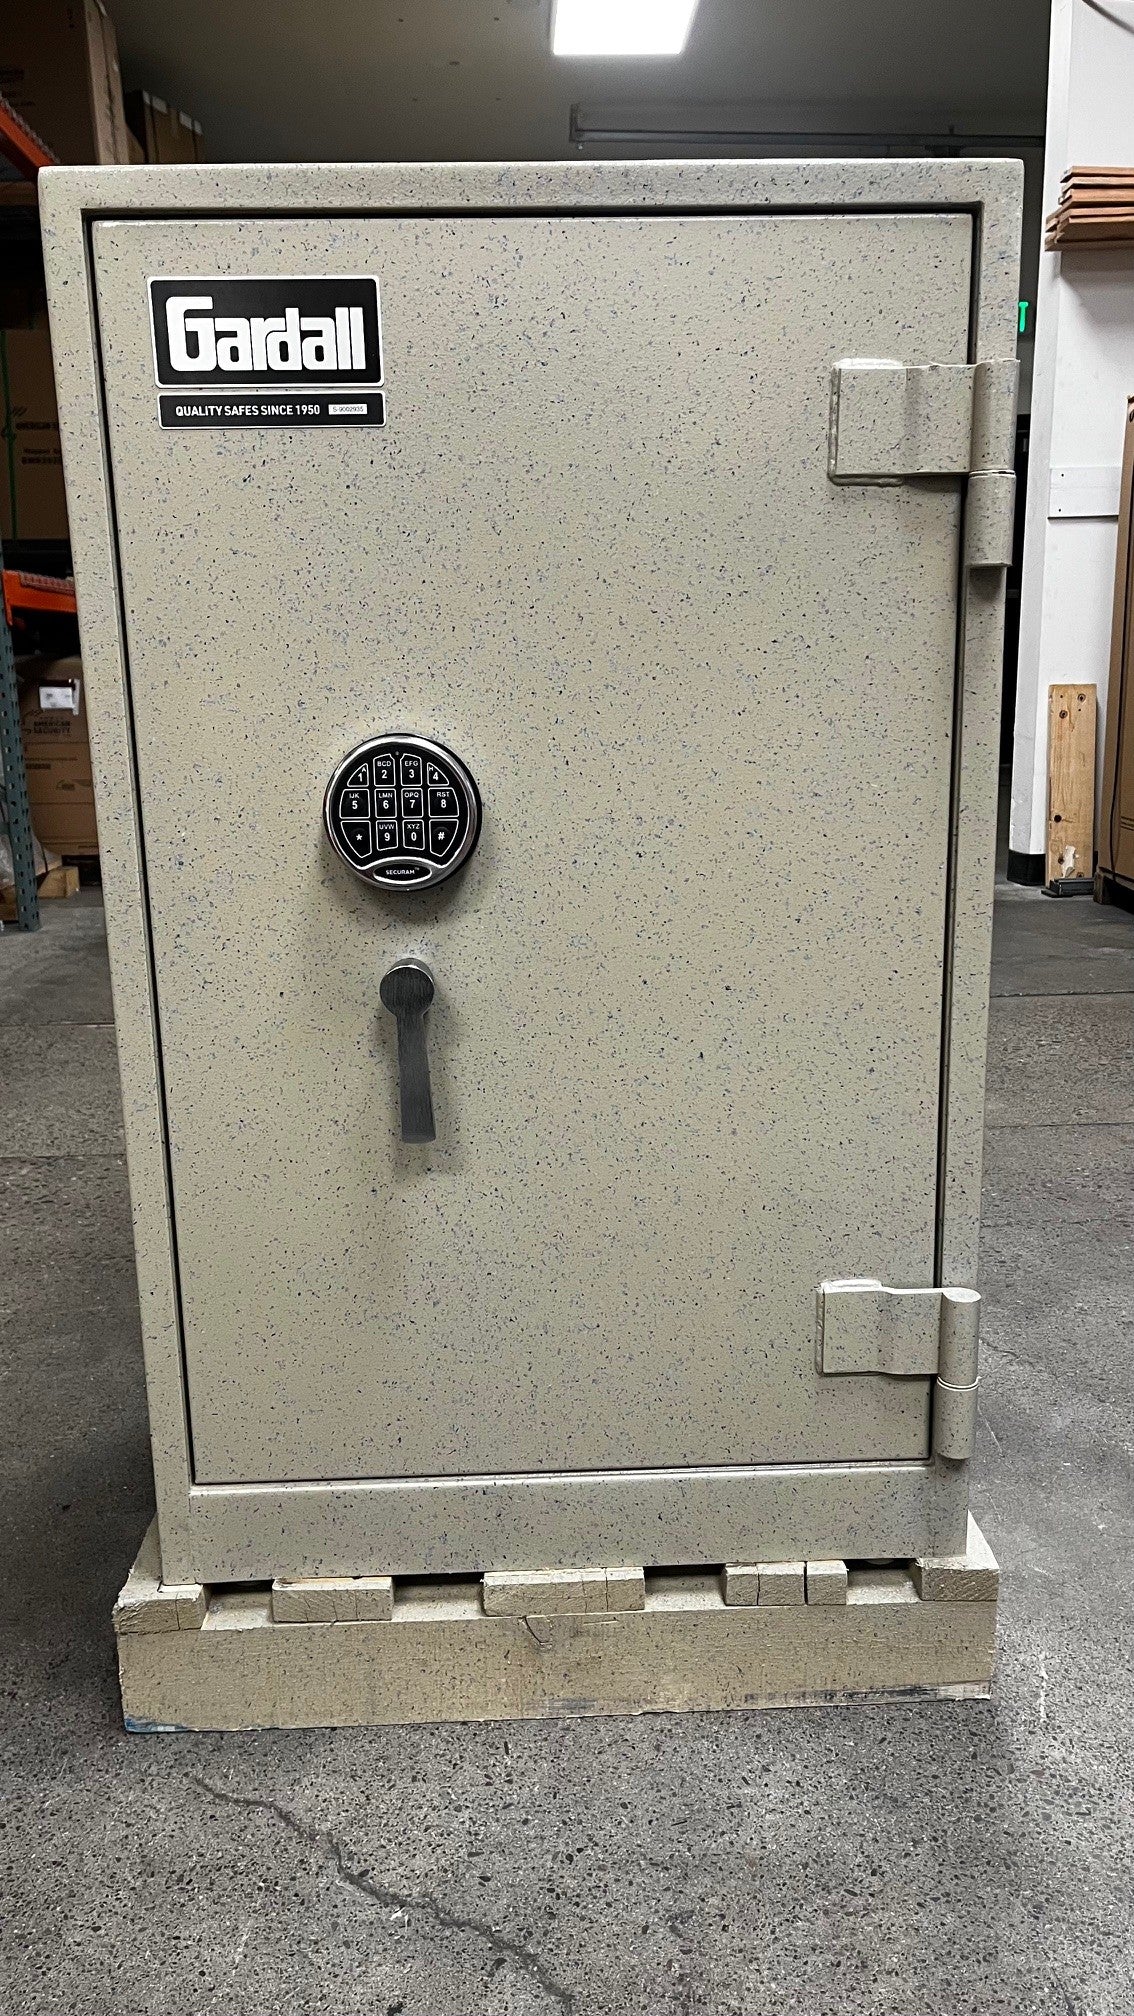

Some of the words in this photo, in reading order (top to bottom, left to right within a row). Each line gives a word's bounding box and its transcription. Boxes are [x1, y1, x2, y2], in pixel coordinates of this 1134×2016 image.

[166, 296, 366, 371] Gardall
[176, 405, 224, 417] QUALITY
[225, 405, 258, 416] SAFES
[261, 405, 293, 416] SINCE
[296, 405, 320, 415] 1950
[358, 773, 363, 781] 1
[381, 770, 387, 778] 2
[409, 769, 415, 778] 3
[433, 772, 439, 780] 4
[352, 801, 358, 809] 5
[383, 800, 389, 809] 6
[409, 800, 415, 808] 7
[441, 799, 447, 808] 8
[384, 833, 390, 841] 9
[411, 832, 417, 841] 0
